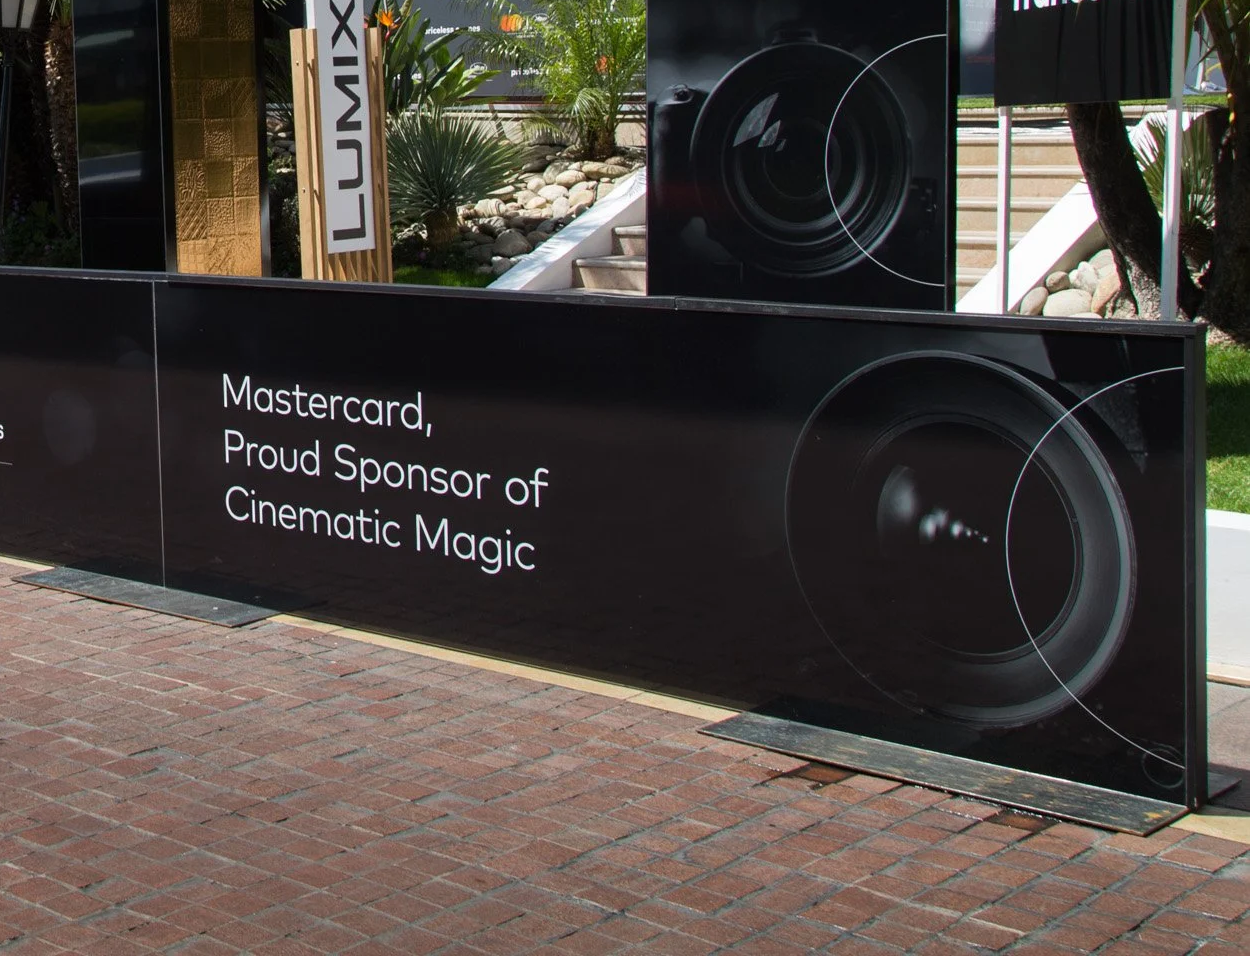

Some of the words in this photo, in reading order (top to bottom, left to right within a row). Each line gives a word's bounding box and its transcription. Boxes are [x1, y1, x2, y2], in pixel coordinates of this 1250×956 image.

[222, 372, 434, 438] Mastercard,
[224, 428, 321, 477] Proud
[333, 443, 491, 500] Sponsor
[504, 467, 550, 509] of
[225, 484, 402, 549] Cinematic
[415, 513, 537, 575] Magic
